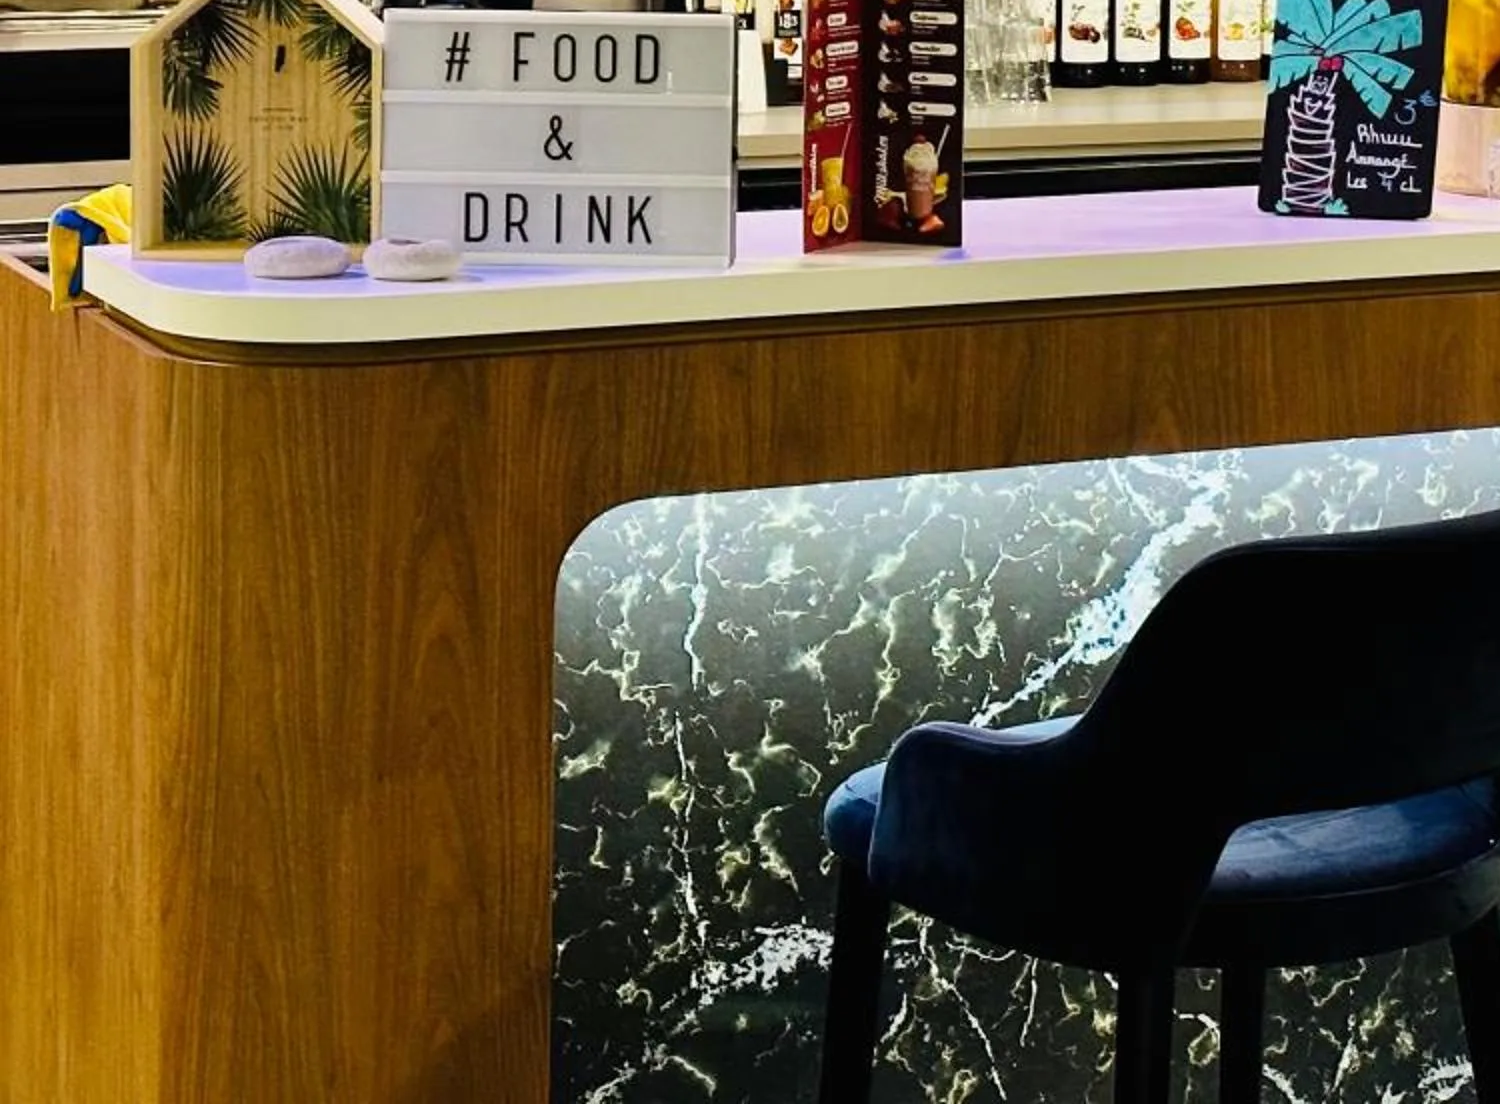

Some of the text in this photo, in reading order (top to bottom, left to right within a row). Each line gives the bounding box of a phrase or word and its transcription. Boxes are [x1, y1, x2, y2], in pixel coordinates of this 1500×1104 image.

[444, 31, 661, 85] # FOOD
[544, 115, 573, 161] &
[463, 192, 653, 245] DRINK
